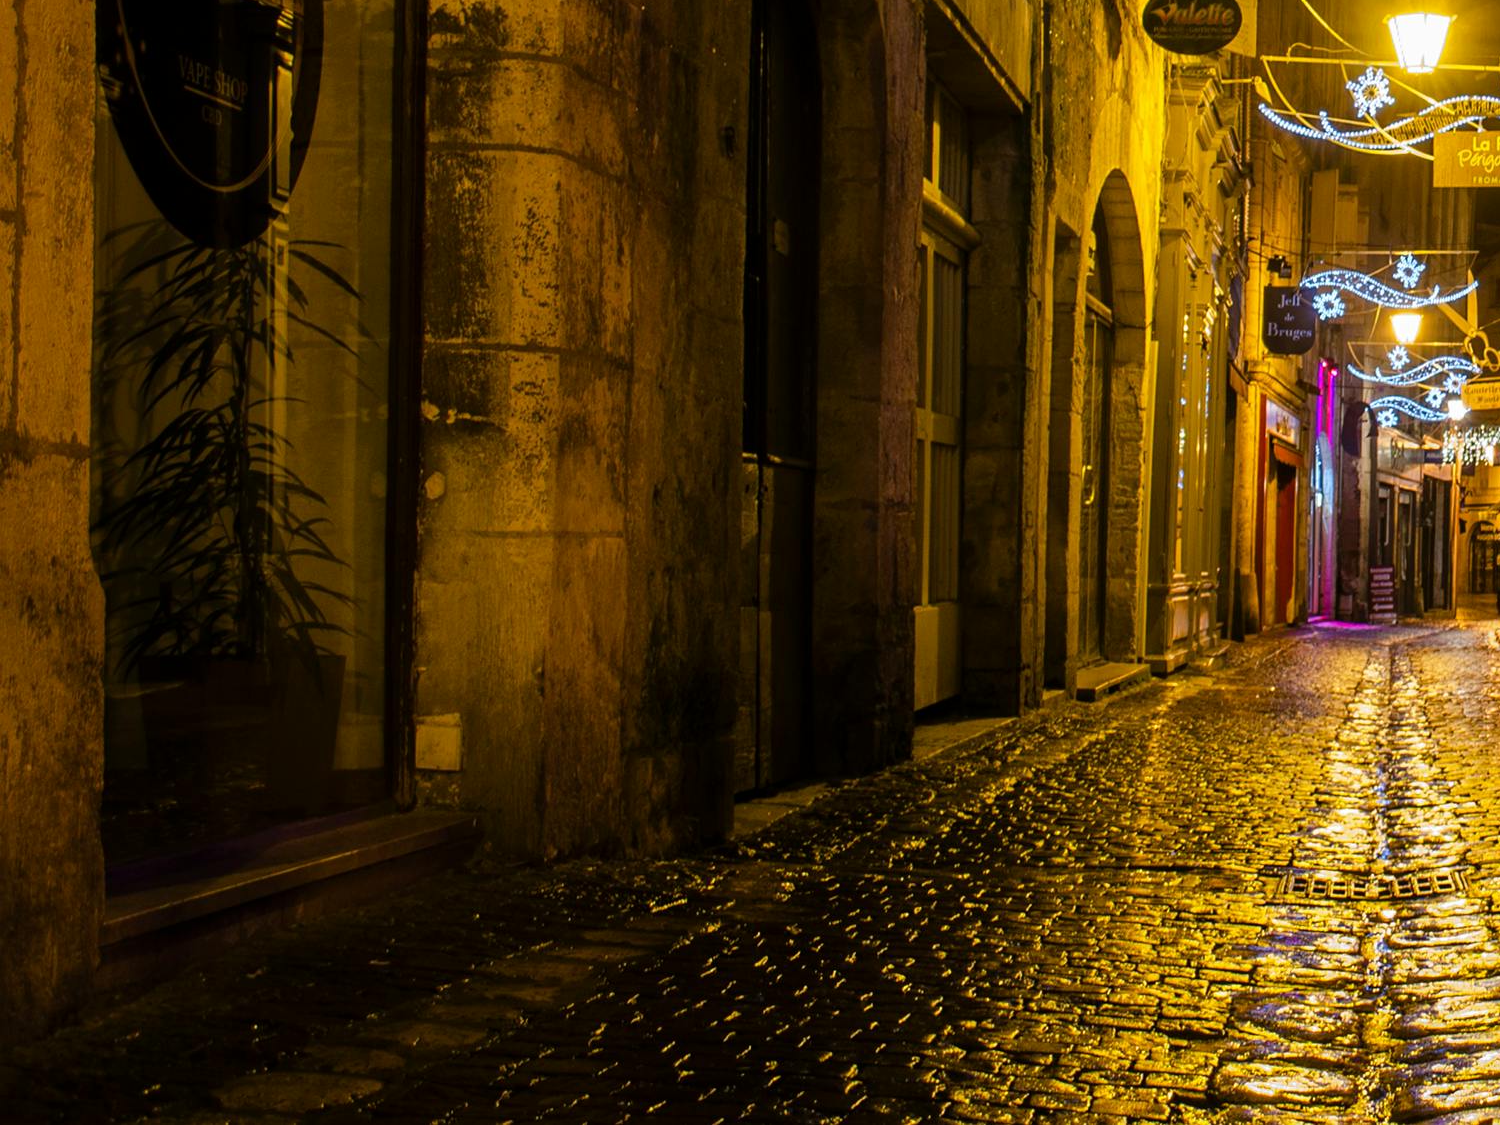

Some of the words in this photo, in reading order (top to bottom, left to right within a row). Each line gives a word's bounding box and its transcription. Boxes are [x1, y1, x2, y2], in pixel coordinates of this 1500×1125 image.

[178, 54, 211, 89] VAPE
[214, 70, 249, 103] SHOP
[1472, 136, 1490, 151] La
[1277, 293, 1302, 309] Jeff
[1284, 312, 1295, 321] de
[1266, 322, 1312, 341] Bruges
